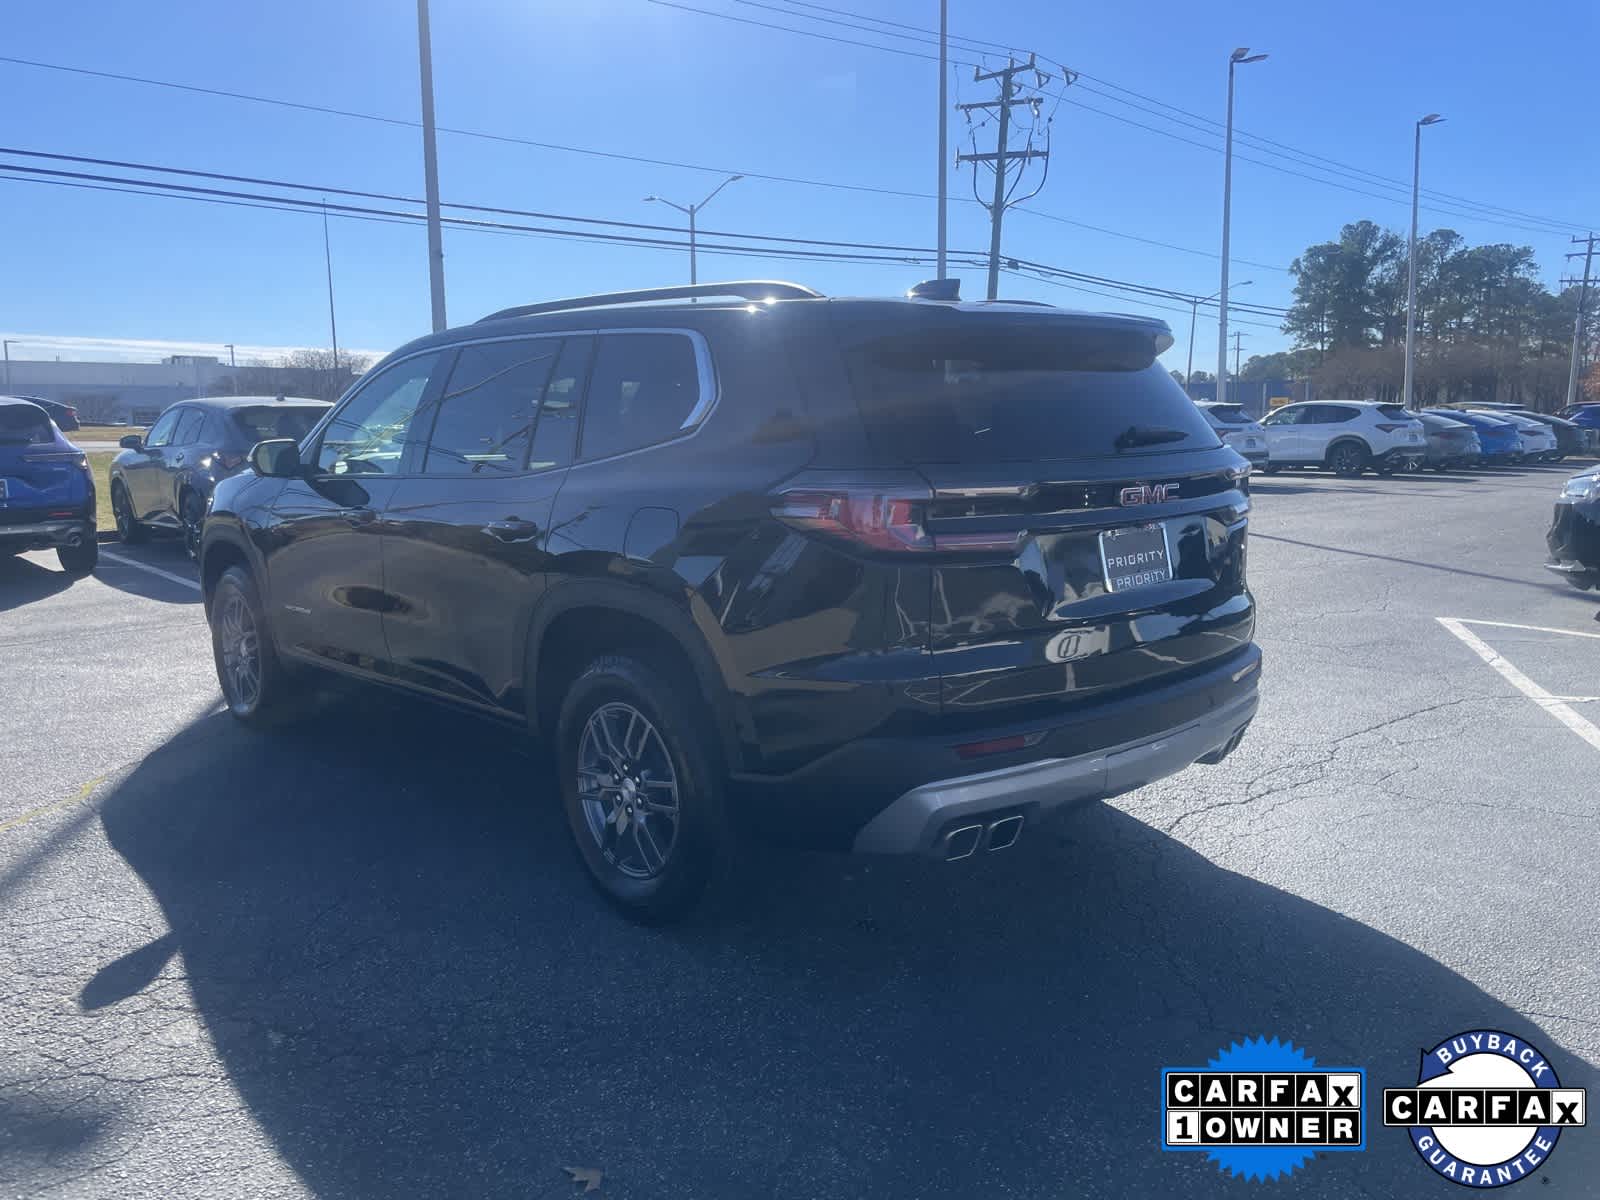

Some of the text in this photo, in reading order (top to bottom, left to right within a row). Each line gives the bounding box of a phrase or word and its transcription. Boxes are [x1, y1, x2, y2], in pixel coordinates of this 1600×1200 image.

[1120, 483, 1180, 507] GMC
[1108, 550, 1164, 569] PRIORITY
[1116, 570, 1167, 589] PRIORITY
